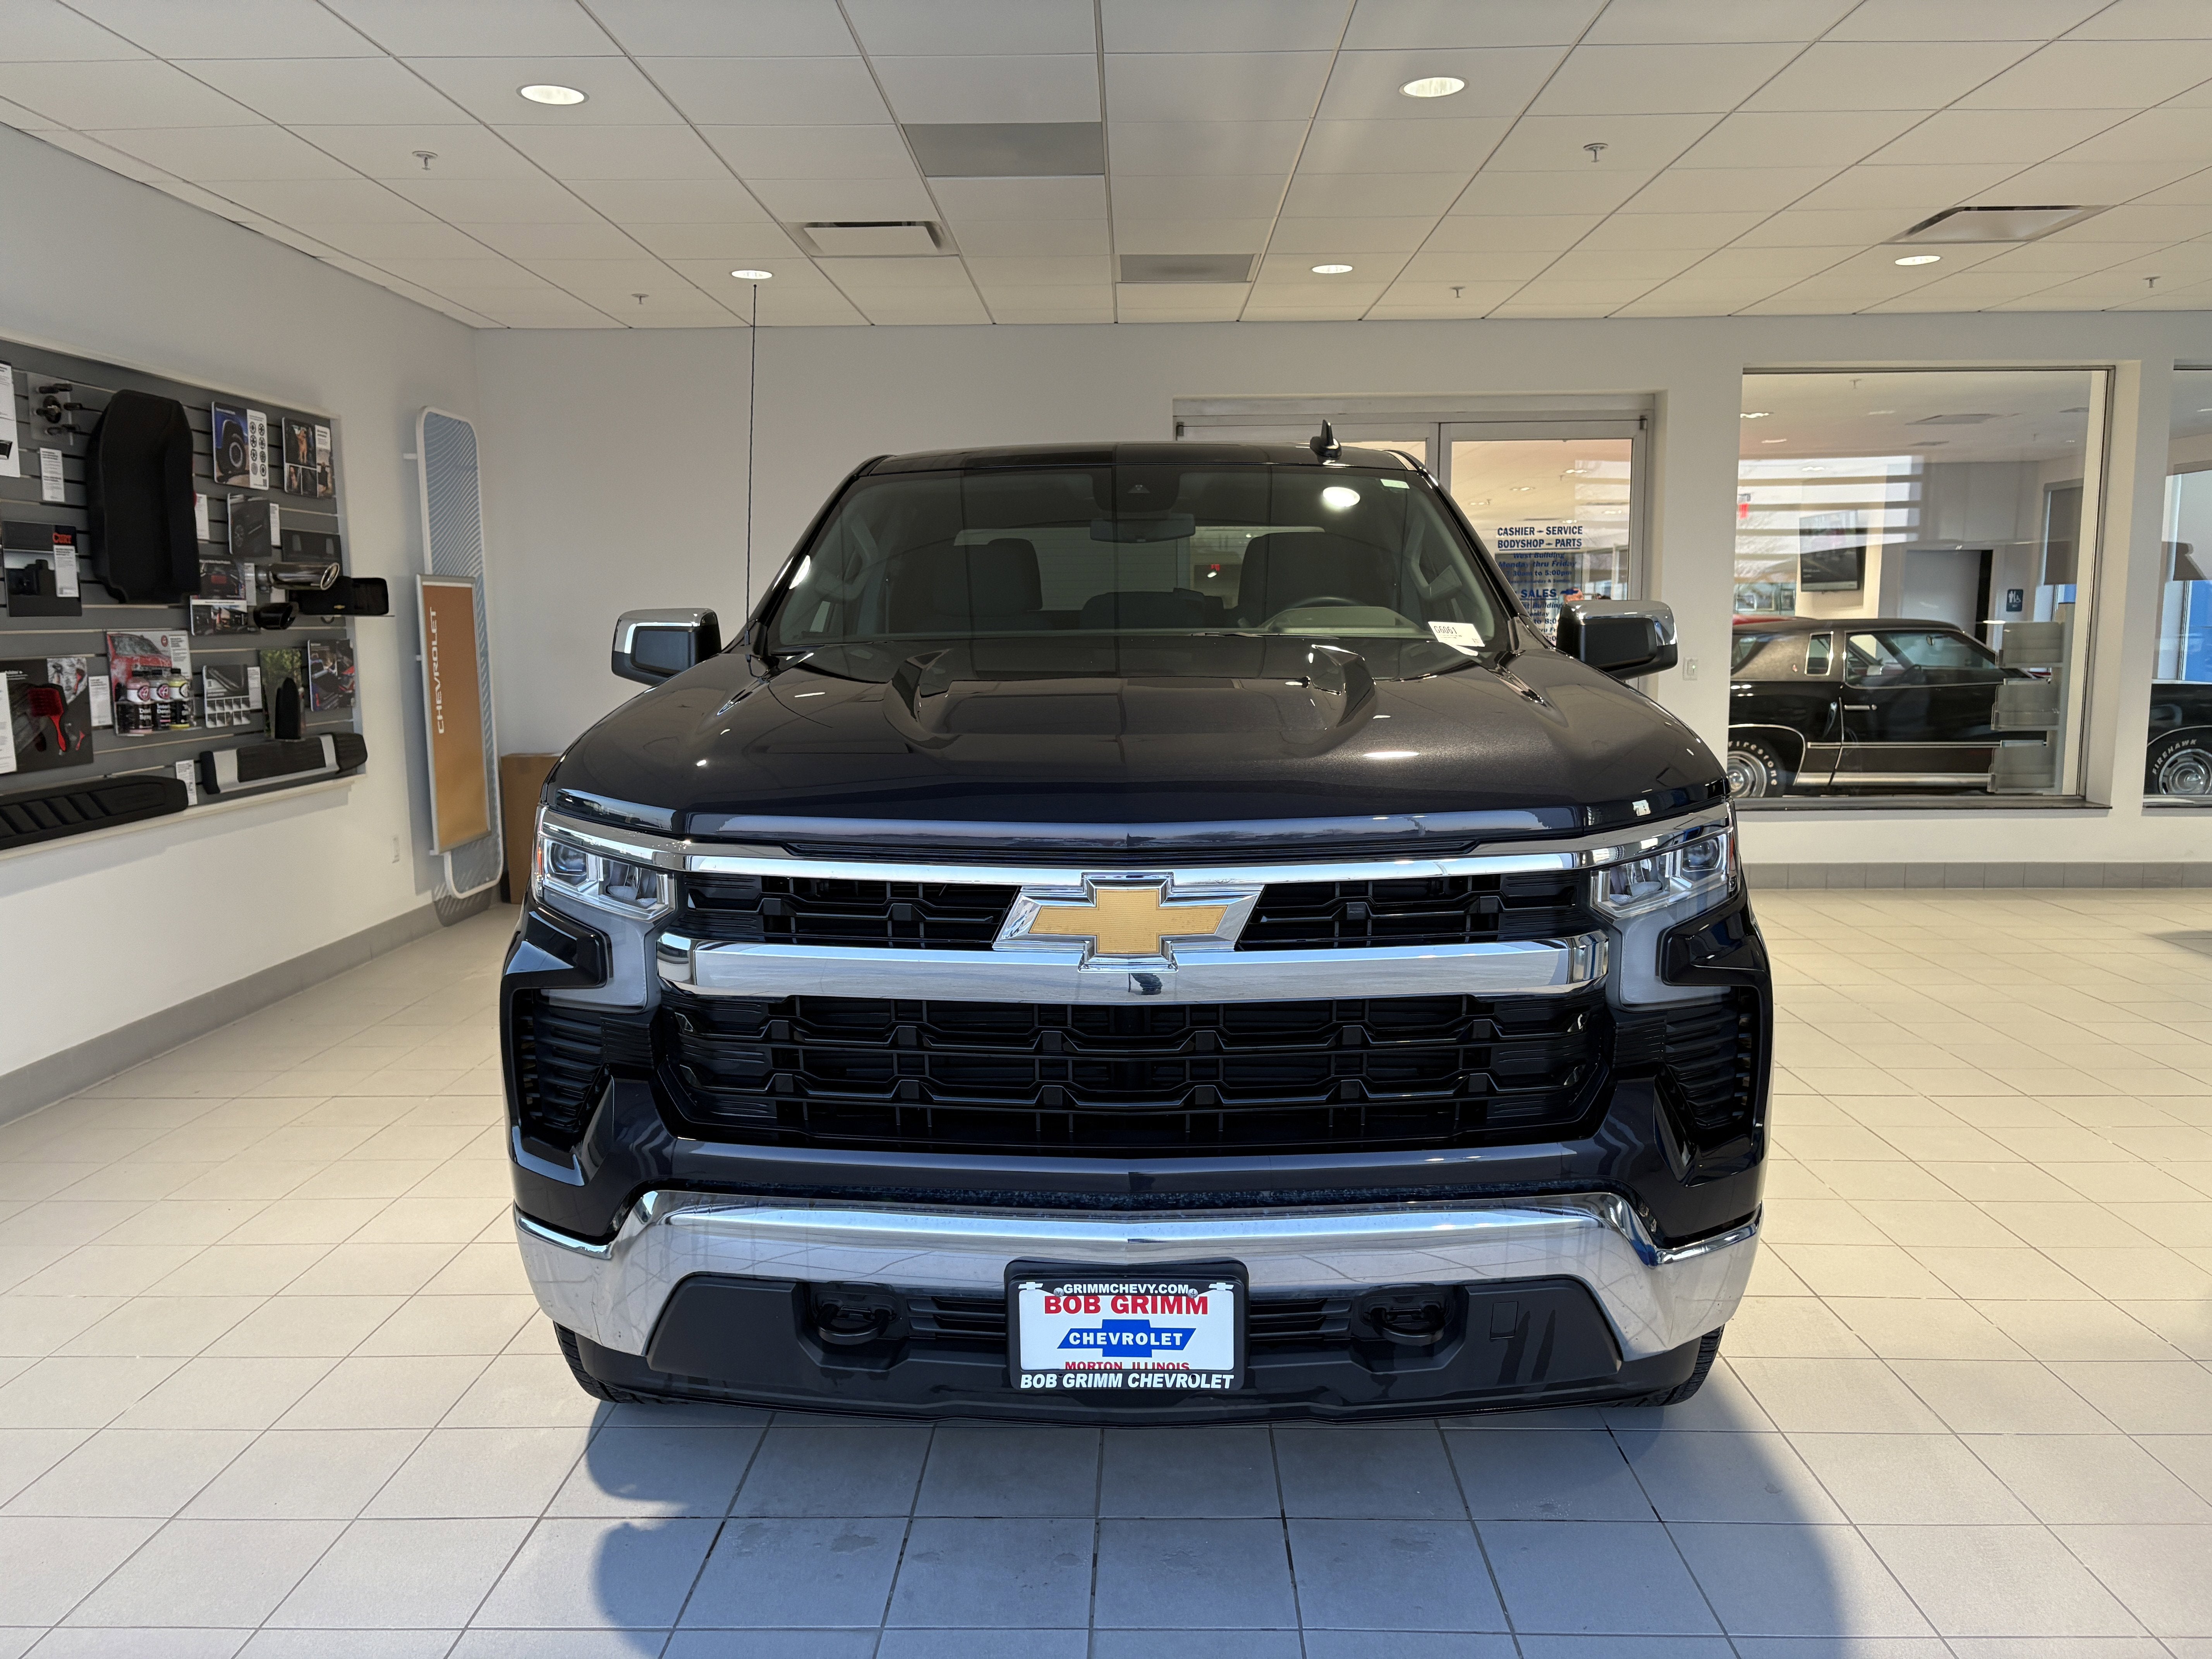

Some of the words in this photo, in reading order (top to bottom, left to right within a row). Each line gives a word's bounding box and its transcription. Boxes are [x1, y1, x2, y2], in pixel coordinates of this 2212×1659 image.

[1497, 527, 1535, 536] CASHIER
[1546, 526, 1583, 535] SERVICE
[1498, 539, 1544, 548] BODYSHOP
[1555, 538, 1582, 547] PARTS
[1520, 589, 1557, 598] SALES
[1434, 625, 1457, 634] G6061
[429, 606, 445, 734] CHEVROLET
[2152, 739, 2197, 775] FIREHAWK
[1063, 1283, 1189, 1294] GRIMMCHEVY.COM
[1044, 1295, 1101, 1314] BOB
[1111, 1295, 1208, 1315] GRIMM
[1069, 1332, 1183, 1346] CHEVROLET
[1132, 1362, 1190, 1370] ILLINOIS
[1020, 1374, 1057, 1389] BOB
[1062, 1374, 1123, 1389] GRIMM
[1127, 1373, 1234, 1389] CHEVROLET
